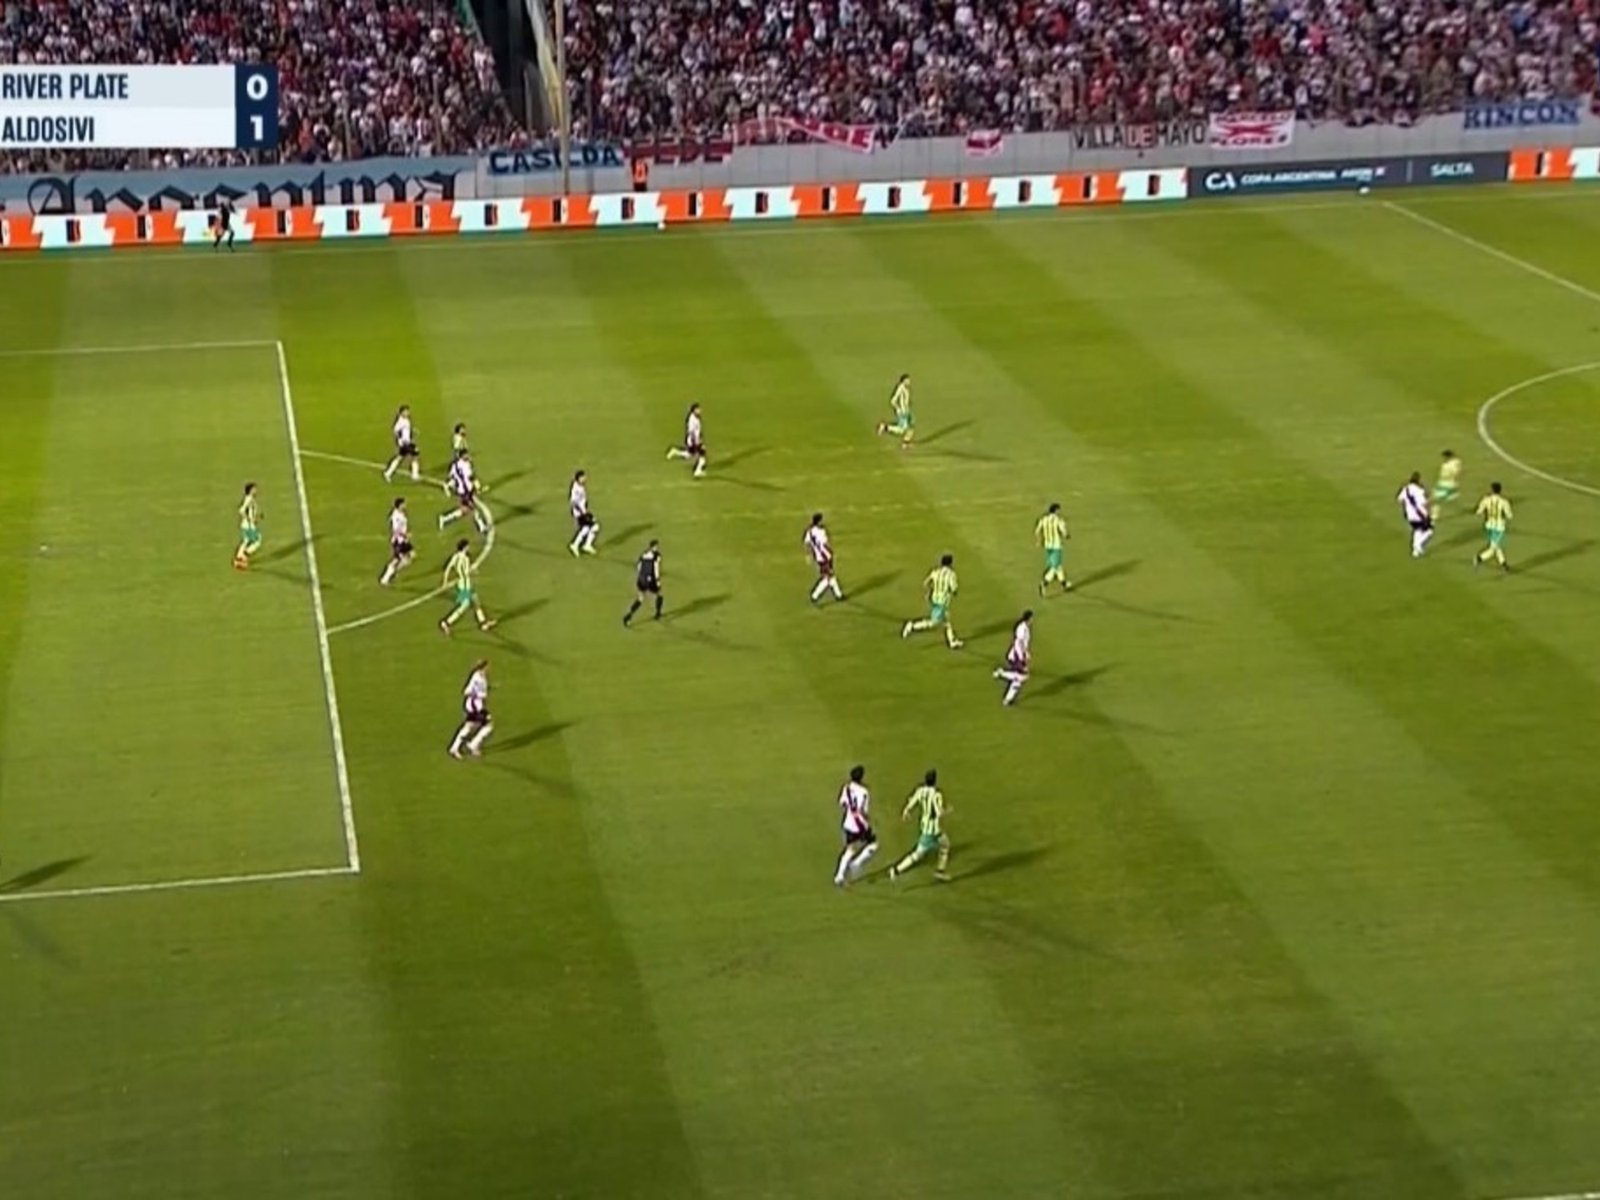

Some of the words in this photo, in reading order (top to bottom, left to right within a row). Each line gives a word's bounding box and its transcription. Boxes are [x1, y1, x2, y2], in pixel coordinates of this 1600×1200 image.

[1074, 126, 1124, 149] VILLA
[1430, 163, 1474, 176] SALTA
[1205, 172, 1236, 190] CA
